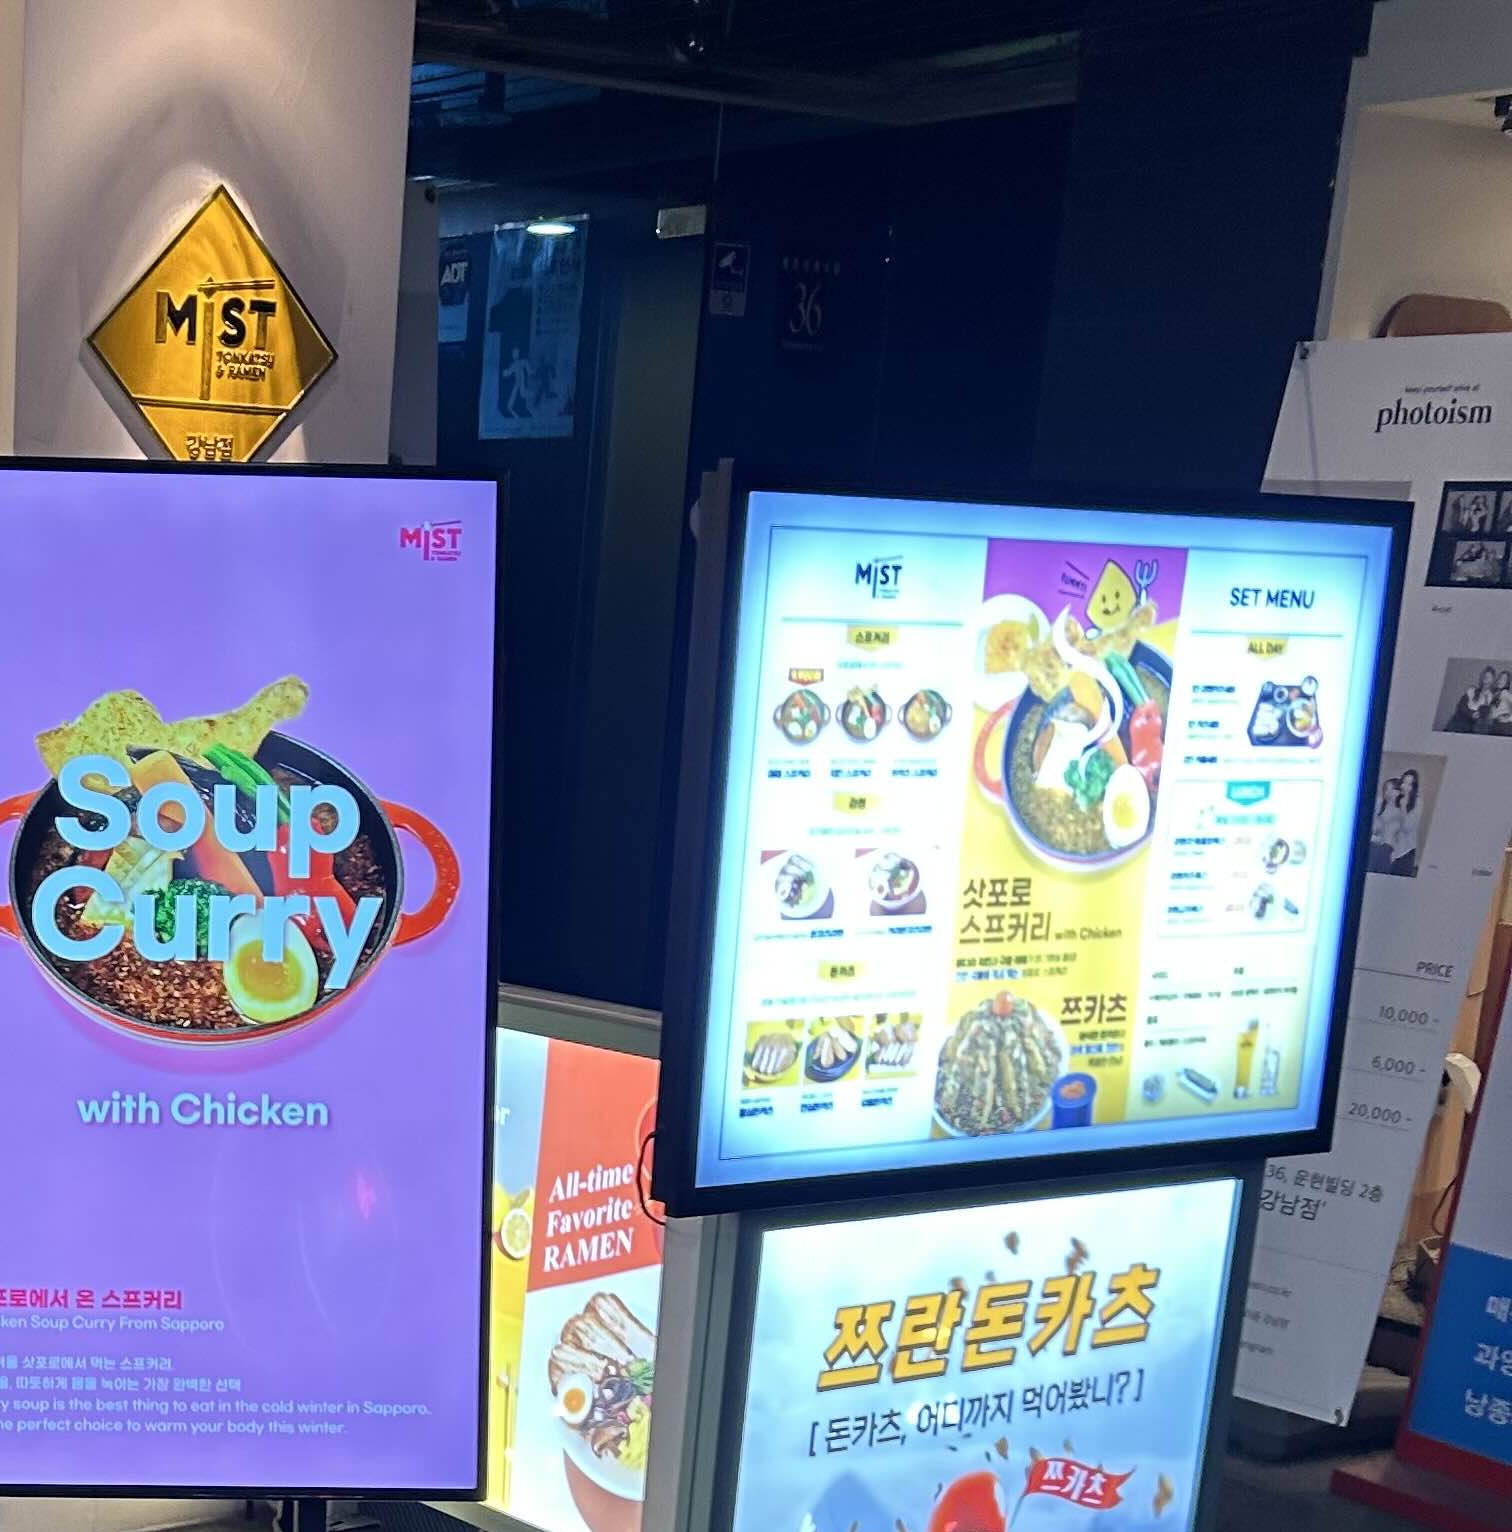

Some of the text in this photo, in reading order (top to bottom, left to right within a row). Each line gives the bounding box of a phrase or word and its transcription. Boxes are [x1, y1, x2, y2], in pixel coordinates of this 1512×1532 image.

[441, 262, 469, 286] ADT
[789, 285, 823, 335] 36
[155, 290, 277, 401] MIST
[1374, 397, 1492, 434] photoism
[399, 527, 463, 561] MIST
[855, 563, 903, 598] MIST
[1230, 587, 1315, 609] SET MENU
[1247, 641, 1265, 655] ALL
[55, 754, 360, 879] Soup
[962, 877, 1032, 910] 삿포로
[31, 866, 383, 990] Curry
[959, 911, 1123, 944] 스프커리 with Chicken
[1416, 961, 1456, 979] PRICE
[1060, 993, 1128, 1025] 쯔카츠
[1379, 1005, 1430, 1026] 10,000
[1371, 1055, 1416, 1075] 6,000
[77, 1091, 329, 1127] with Chicken
[1348, 1102, 1403, 1125] 20,000
[548, 1163, 634, 1203] All-time
[546, 1196, 634, 1239] Favorite
[543, 1226, 635, 1273] RAMEN
[75, 1288, 95, 1310] 온
[101, 1289, 183, 1311] 스프커리
[31, 1315, 69, 1332] Soup
[72, 1316, 116, 1333] Curry
[119, 1316, 158, 1330] From
[161, 1316, 225, 1333] Sapporo
[816, 1262, 1161, 1392] 쯔란돈카츠
[13, 1399, 50, 1413] soup
[53, 1397, 66, 1411] is
[69, 1397, 93, 1411] the
[96, 1398, 128, 1411] best
[132, 1398, 169, 1415] thing
[173, 1399, 187, 1412] to
[191, 1400, 215, 1413] eat
[218, 1399, 232, 1413] in
[235, 1400, 258, 1413] the
[262, 1400, 293, 1413] cold
[297, 1400, 343, 1415] winter
[347, 1401, 360, 1414] in
[363, 1401, 432, 1417] Sapporo.
[916, 1389, 1014, 1436] 어디까지
[17, 1417, 71, 1433] perfect
[74, 1417, 123, 1432] choice
[126, 1418, 141, 1432] to
[145, 1420, 187, 1433] warm
[190, 1420, 224, 1436] your
[227, 1419, 264, 1436] body
[268, 1419, 295, 1434] this
[1040, 1460, 1108, 1505] 쯔카츠
